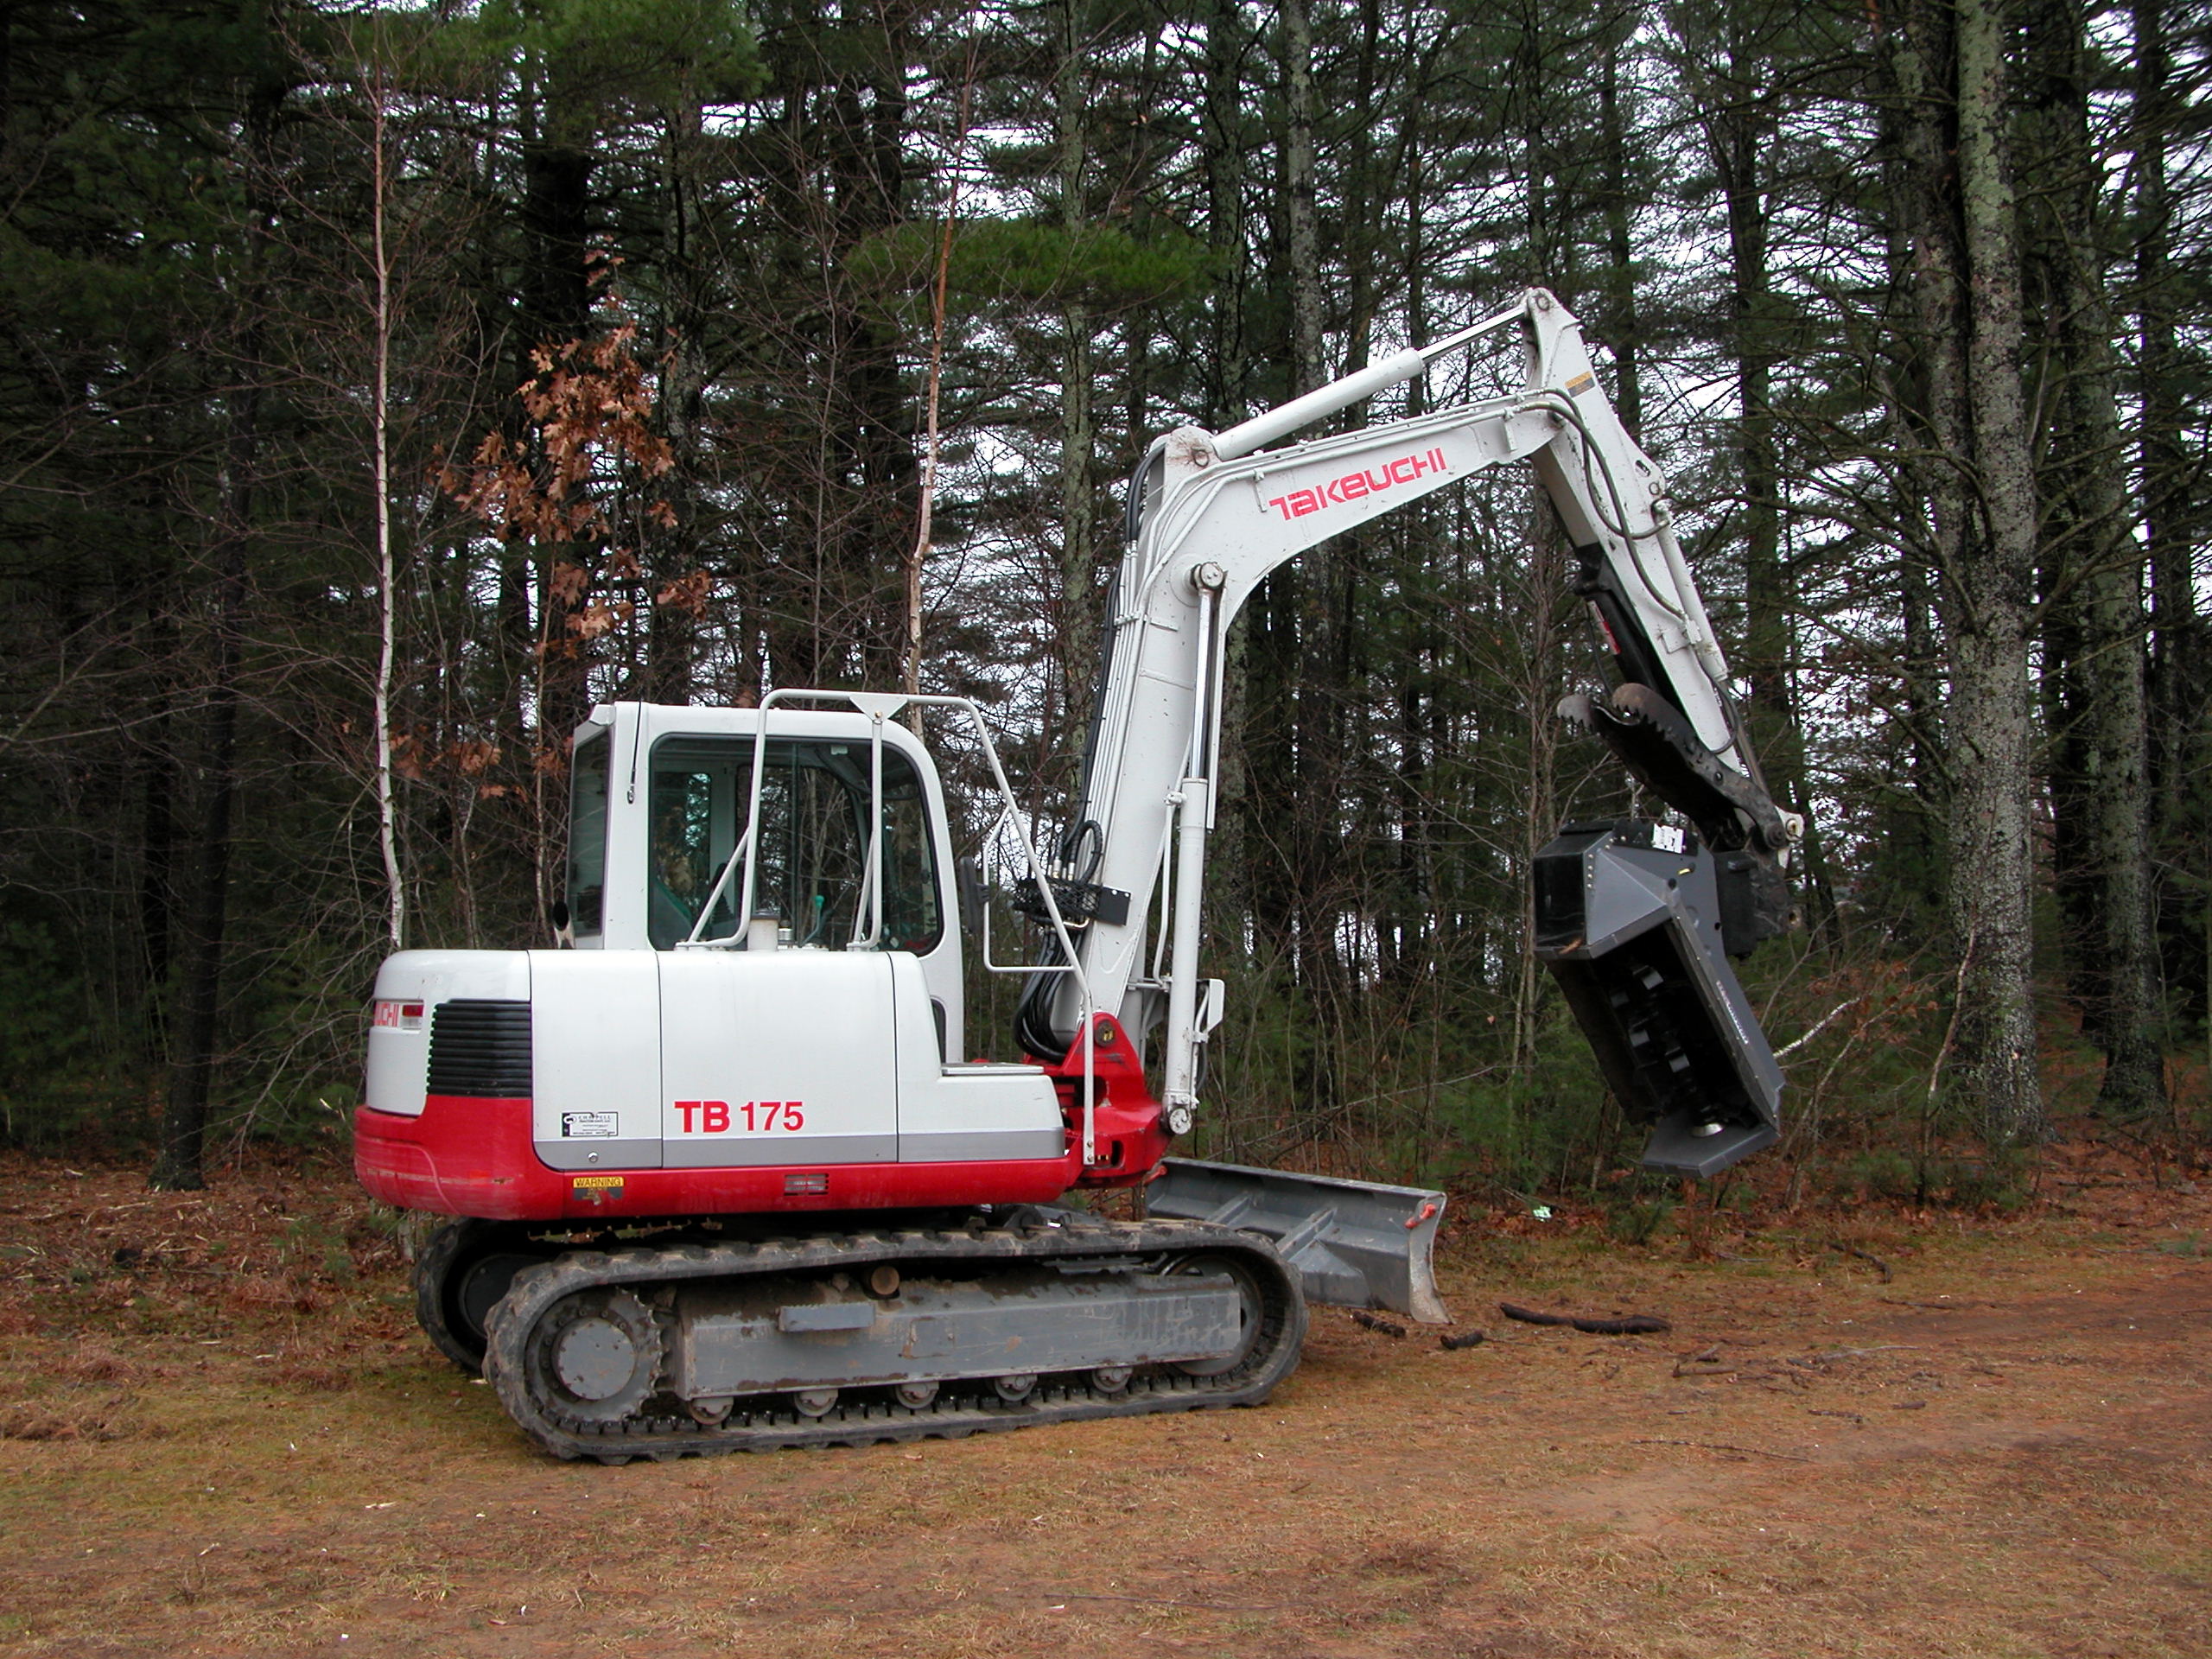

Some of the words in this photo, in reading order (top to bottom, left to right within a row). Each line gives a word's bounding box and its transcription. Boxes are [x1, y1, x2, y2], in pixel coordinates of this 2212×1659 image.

[1268, 448, 1447, 521] TAKEUCHI
[674, 1101, 730, 1133] TB
[741, 1101, 804, 1132] 175
[575, 1178, 621, 1187] WARNING
